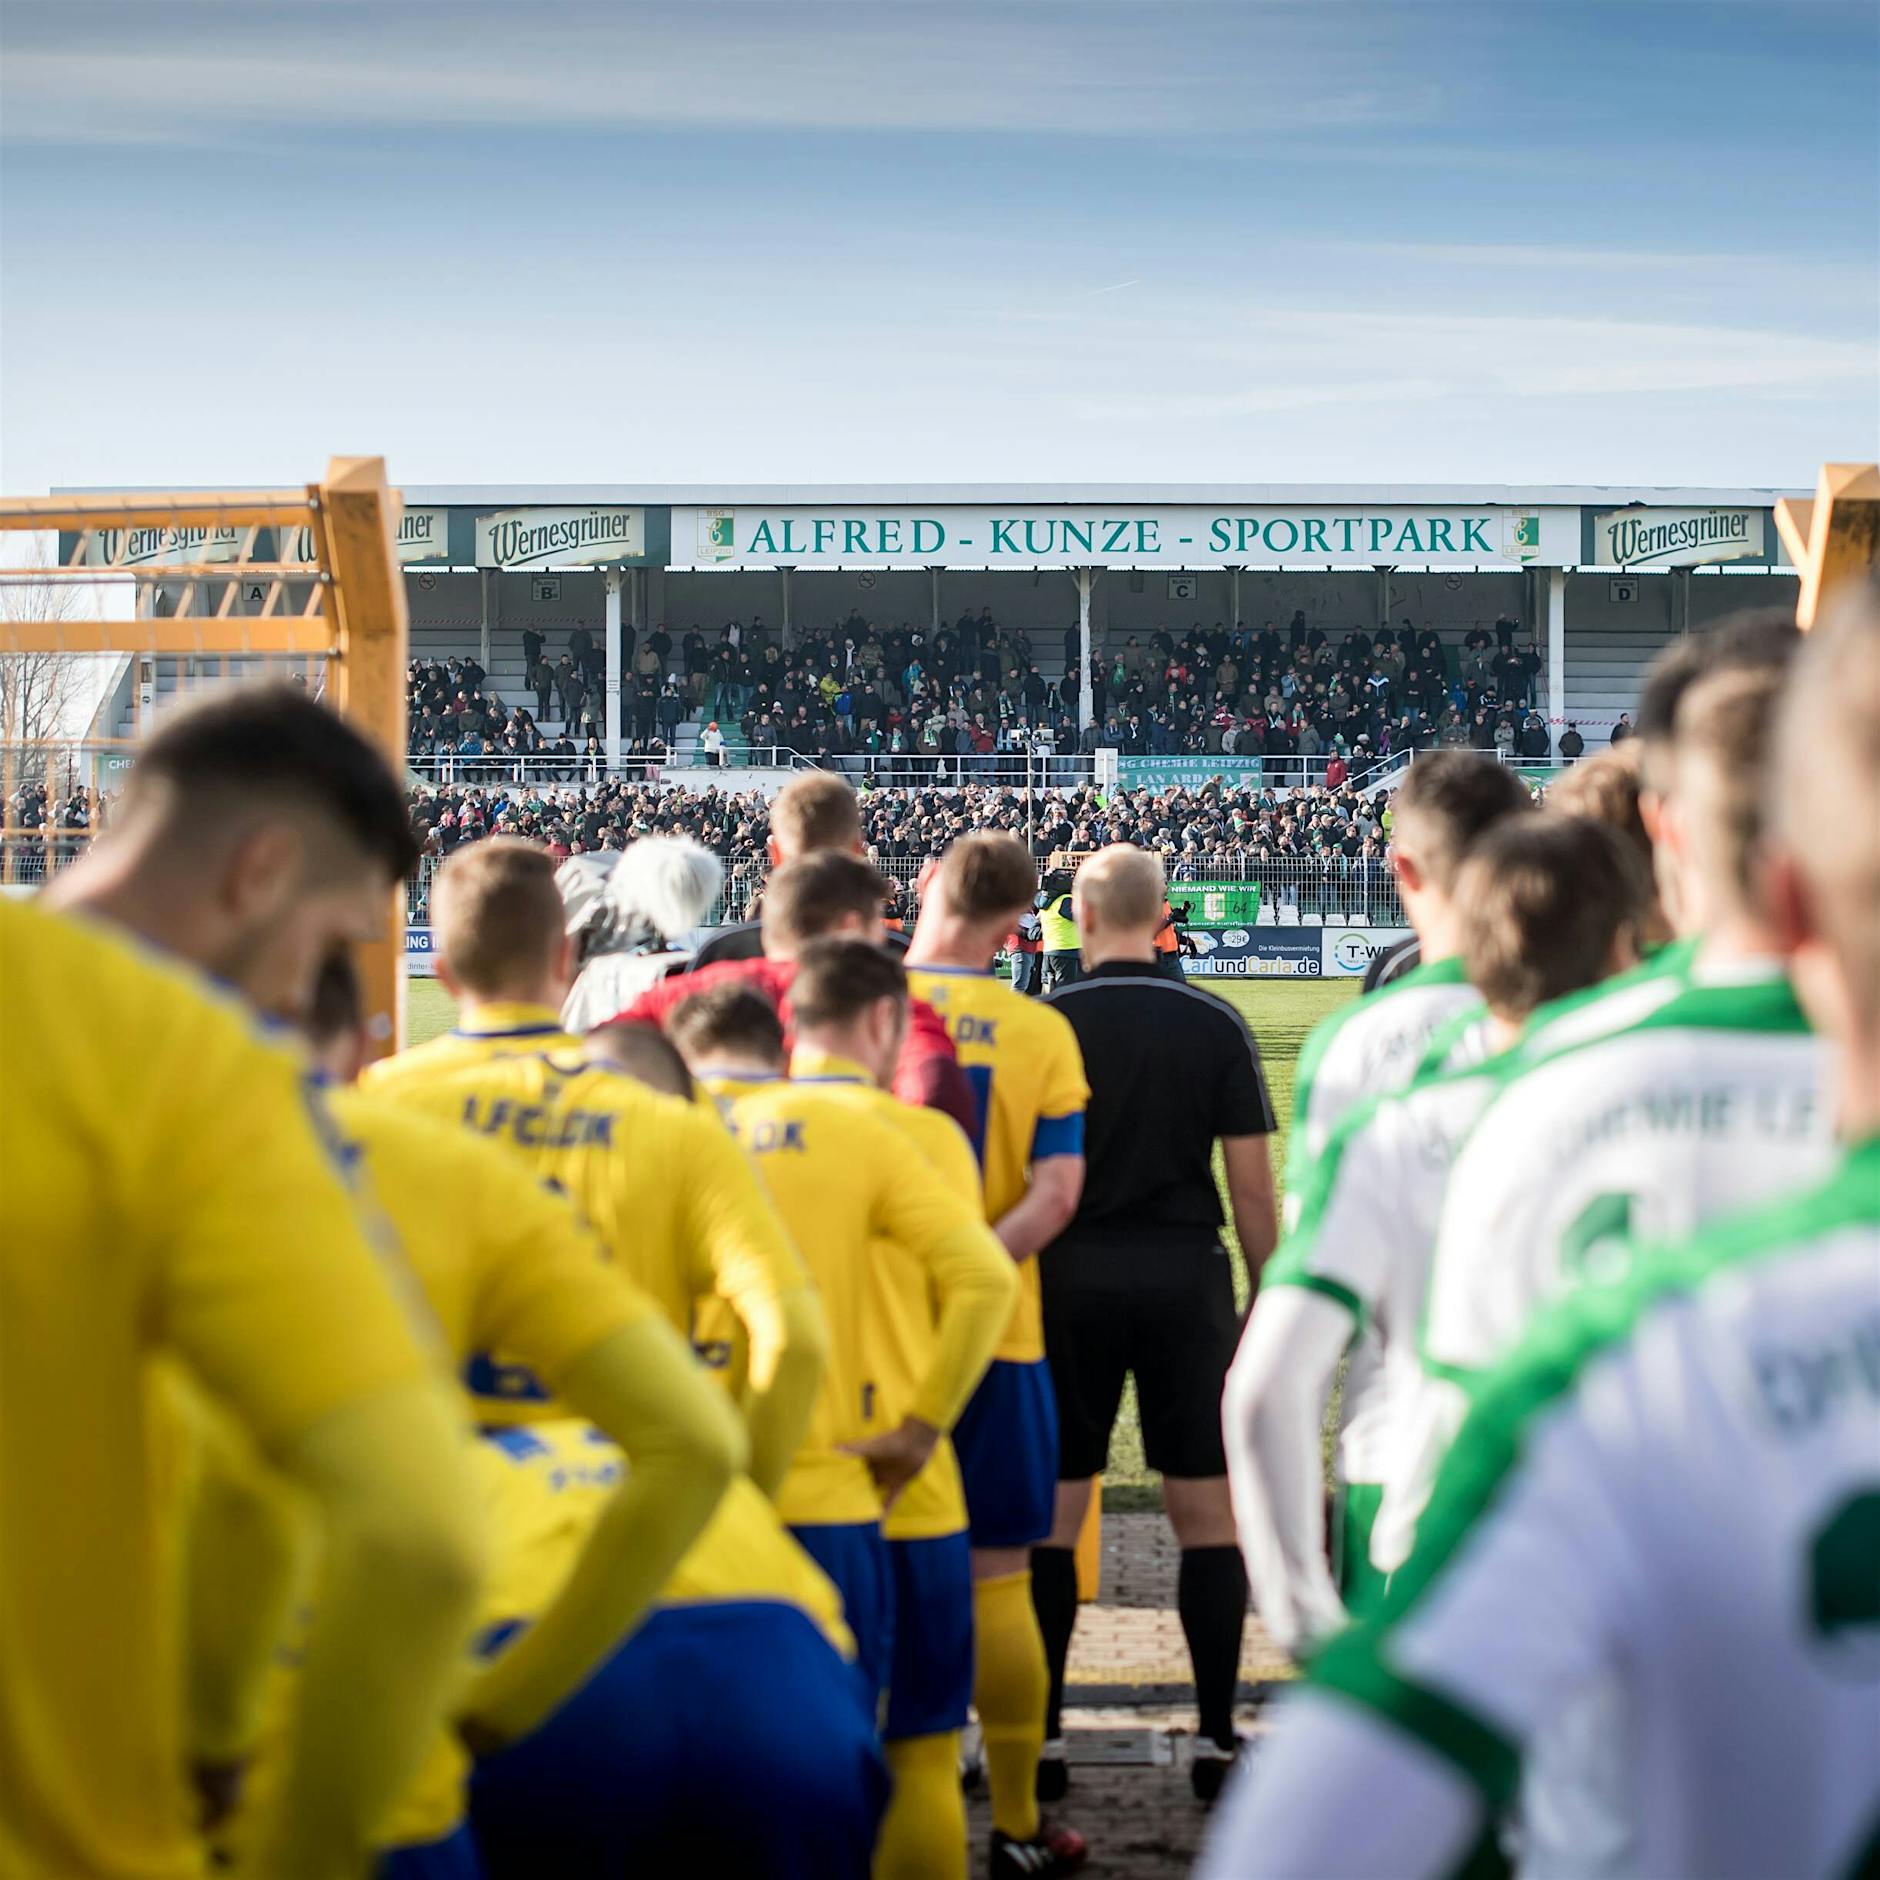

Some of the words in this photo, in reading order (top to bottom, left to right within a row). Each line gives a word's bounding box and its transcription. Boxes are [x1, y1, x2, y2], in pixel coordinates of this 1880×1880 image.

[488, 511, 631, 566] Wernesgrüner
[746, 519, 946, 553] ALFRED
[989, 519, 1162, 554] KUNZE
[1208, 518, 1494, 553] SPORTPARK
[1608, 510, 1749, 564] Wernesgrüner
[700, 547, 732, 555] LEIPZIG
[1504, 547, 1537, 555] LEIPZIG
[250, 587, 263, 600] A
[541, 586, 553, 599] B
[1176, 584, 1189, 598] C
[1618, 588, 1631, 601] D
[1118, 759, 1136, 769] SG
[1140, 758, 1198, 769] CHEMIE
[1202, 758, 1260, 769] LEIPZIG
[1171, 885, 1217, 893] NIEMAND
[1218, 885, 1236, 893] WIE
[1258, 944, 1268, 952] Die
[1269, 944, 1321, 953] Kleinbusvermietung
[1181, 955, 1319, 974] CarlundCarla.de
